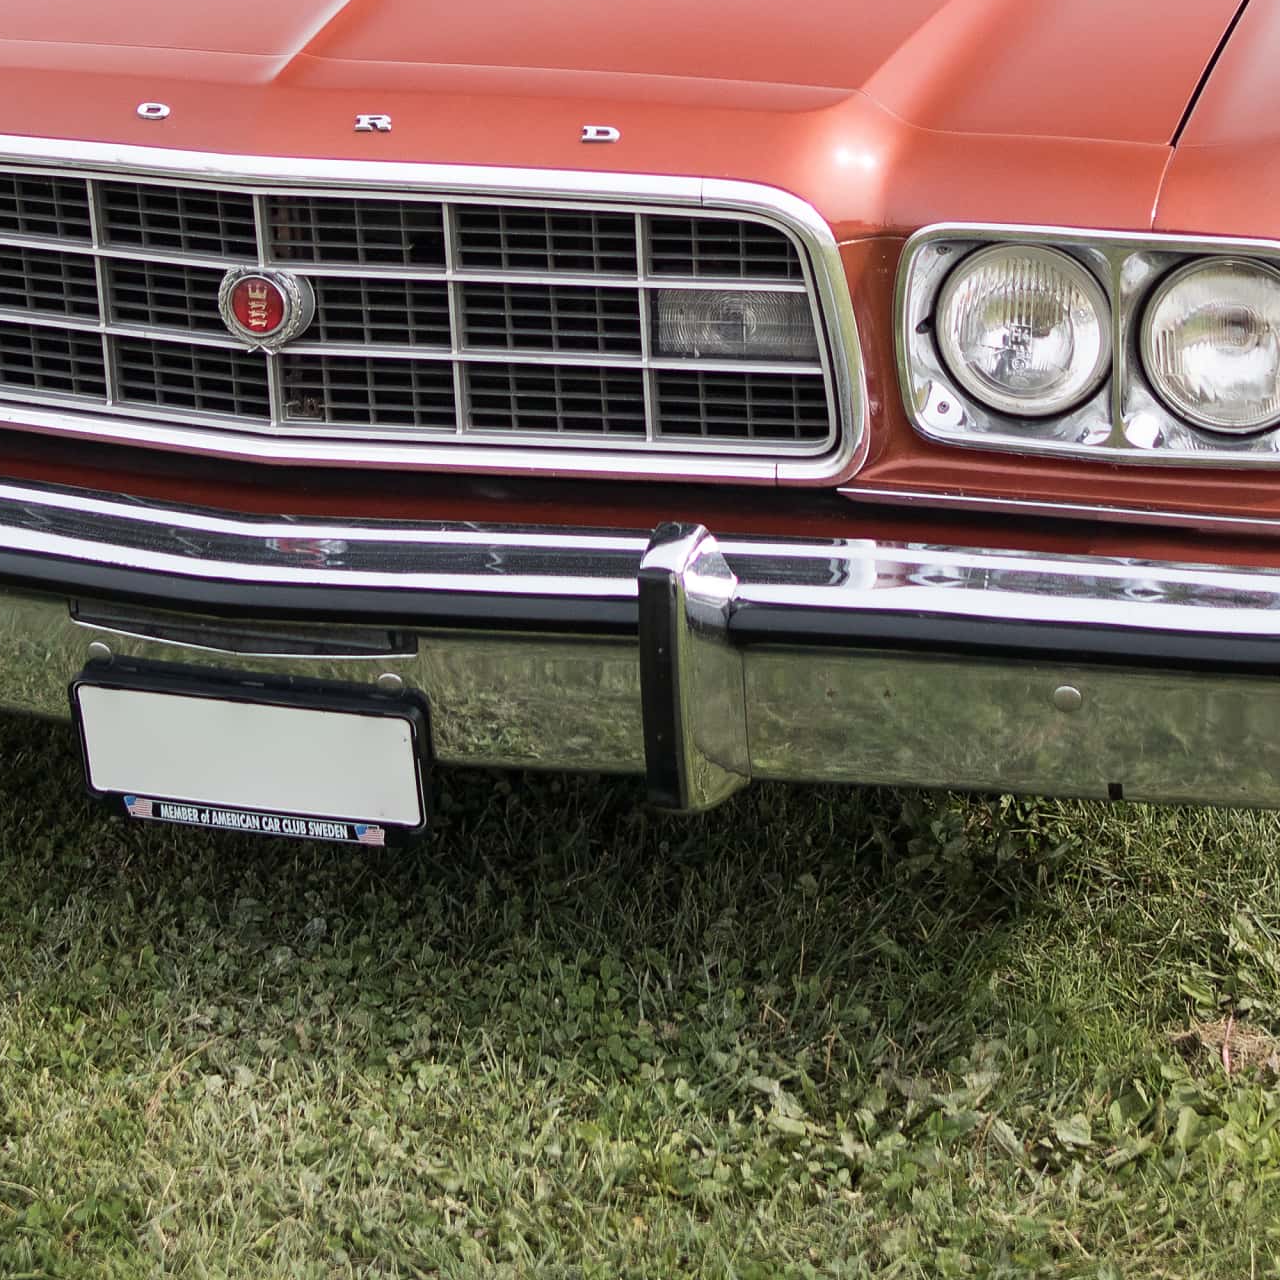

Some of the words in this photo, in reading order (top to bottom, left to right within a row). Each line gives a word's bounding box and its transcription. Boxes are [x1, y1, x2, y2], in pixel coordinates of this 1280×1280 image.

[160, 804, 199, 822] MEMBER
[201, 810, 211, 824] of
[211, 811, 260, 830] AMERICAN
[262, 817, 281, 832] CAR
[282, 818, 307, 835] CLUB
[308, 821, 349, 839] SWEDEN
